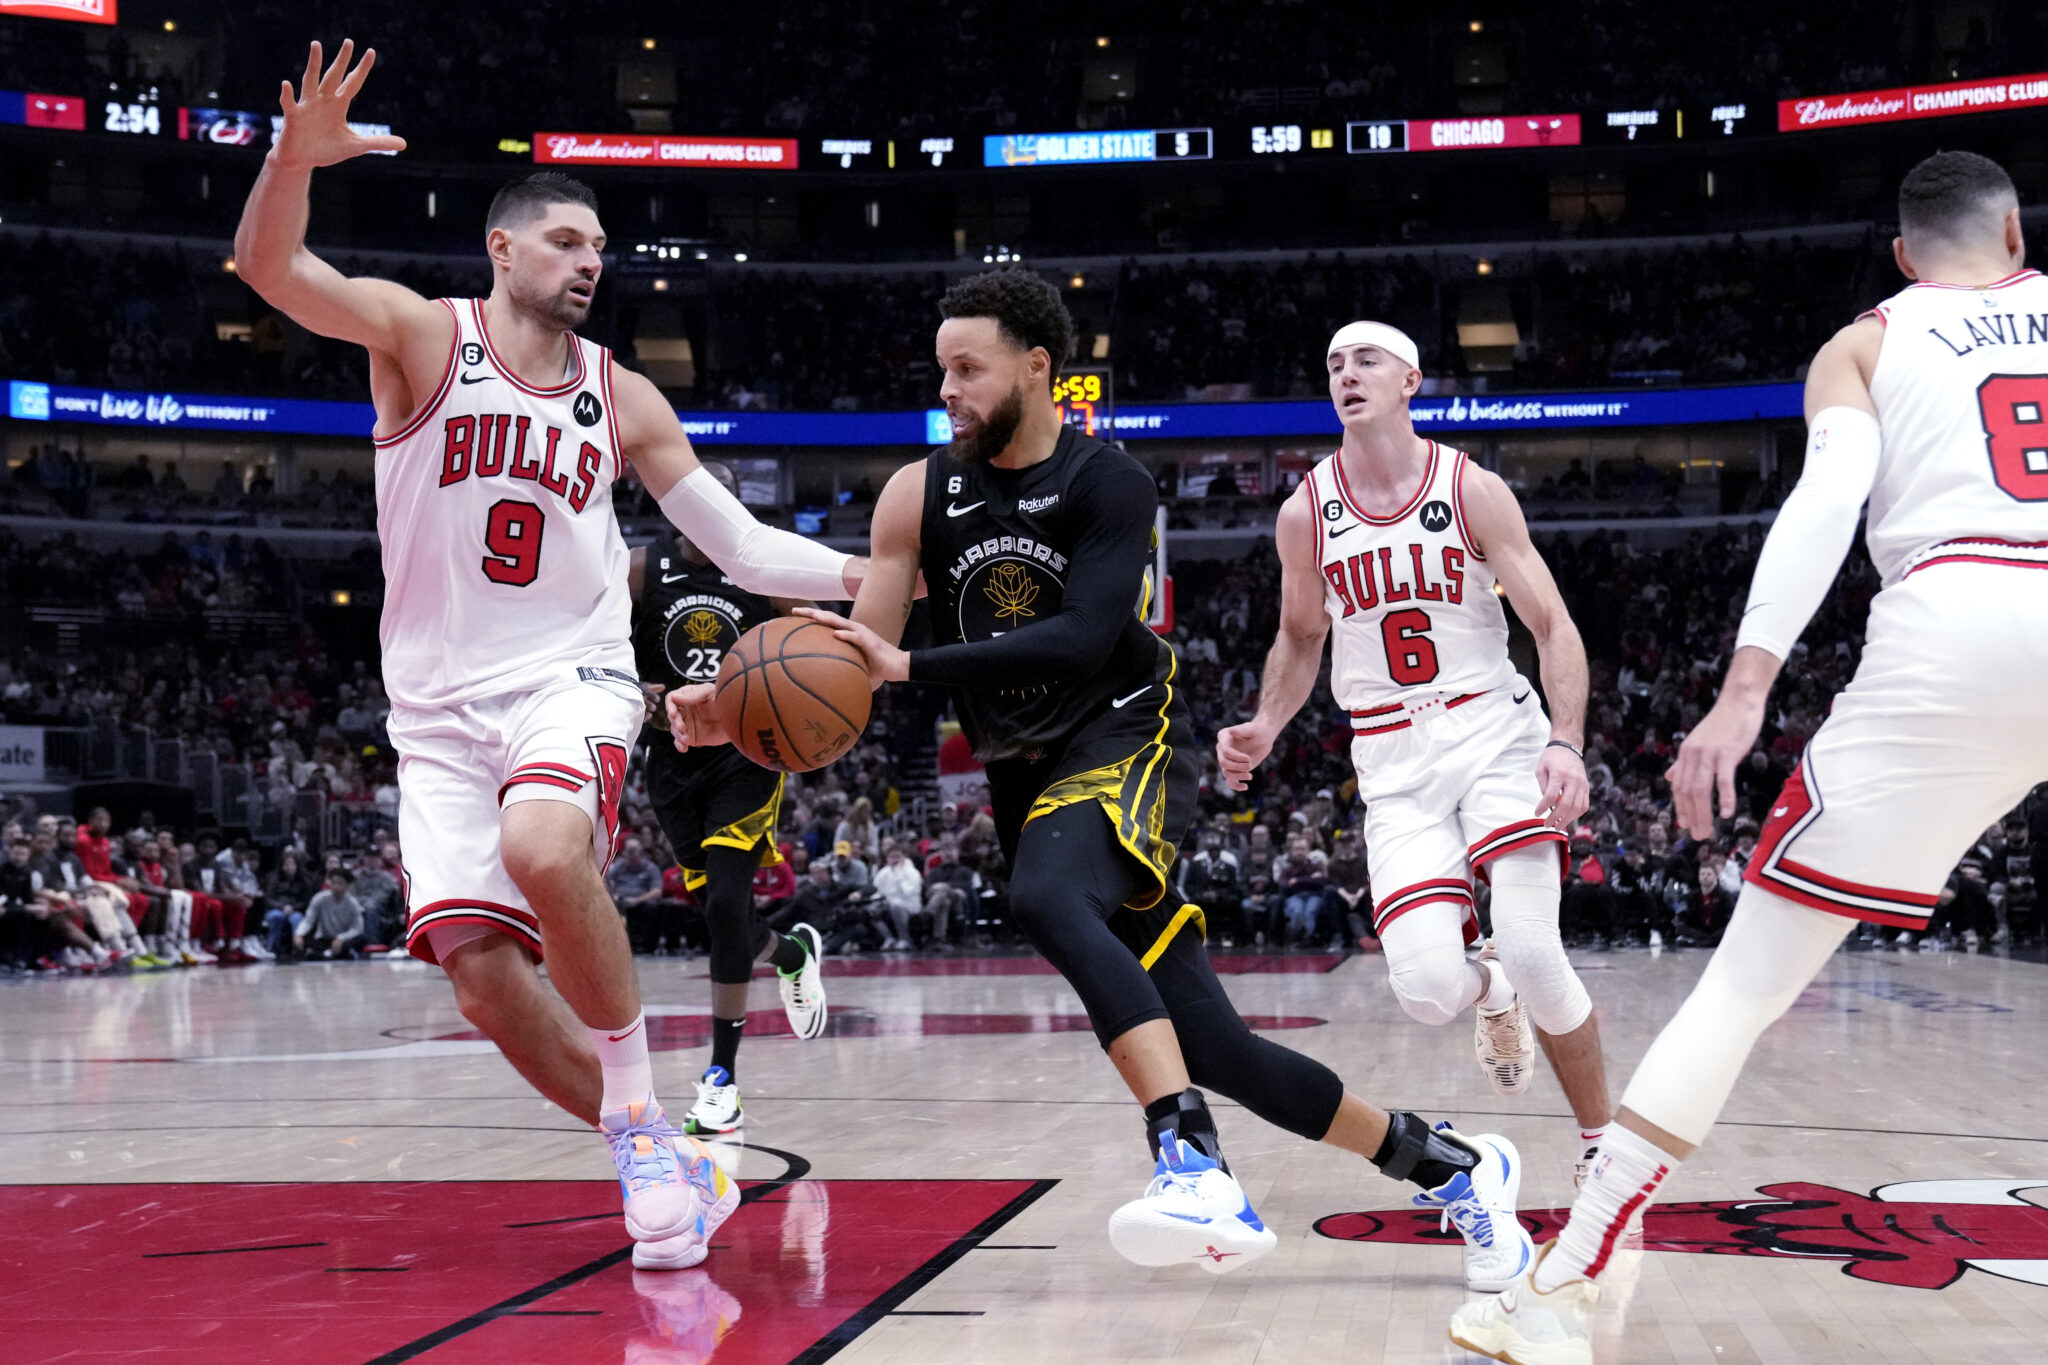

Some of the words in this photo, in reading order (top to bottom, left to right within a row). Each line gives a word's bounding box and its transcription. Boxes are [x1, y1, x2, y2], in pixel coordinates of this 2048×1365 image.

[1795, 96, 1904, 124] Budweiser
[1913, 85, 2006, 111] CHAMPIONS
[2008, 80, 2048, 101] CLUB
[105, 102, 160, 134] 2:54
[1431, 118, 1505, 146] CHICAGO
[547, 136, 653, 158] Budweiser
[660, 143, 744, 161] CHAMPIONS
[746, 145, 783, 162] CLUB
[1036, 135, 1099, 161] GOLDEN
[1101, 132, 1152, 158] STATE
[1251, 125, 1301, 153] 5:59
[1928, 313, 2048, 357] LAVIN
[465, 346, 479, 363] 6
[101, 392, 144, 419] live
[145, 394, 184, 424] life
[185, 404, 251, 421] WITHOUT
[1446, 397, 1468, 422] do
[1469, 398, 1542, 421] business
[1543, 403, 1606, 418] WITHOUT
[1976, 373, 2048, 503] 8
[439, 413, 602, 515] BULLS
[947, 476, 962, 494] 6
[1018, 494, 1059, 513] Rakuten
[1327, 503, 1339, 519] 6
[481, 498, 545, 587] 9
[660, 557, 670, 570] 6
[949, 535, 1069, 580] WARRIORS
[1323, 543, 1465, 620] BULLS
[663, 594, 743, 621] WARRIORS
[1380, 607, 1440, 687] 6
[685, 648, 721, 677] 23
